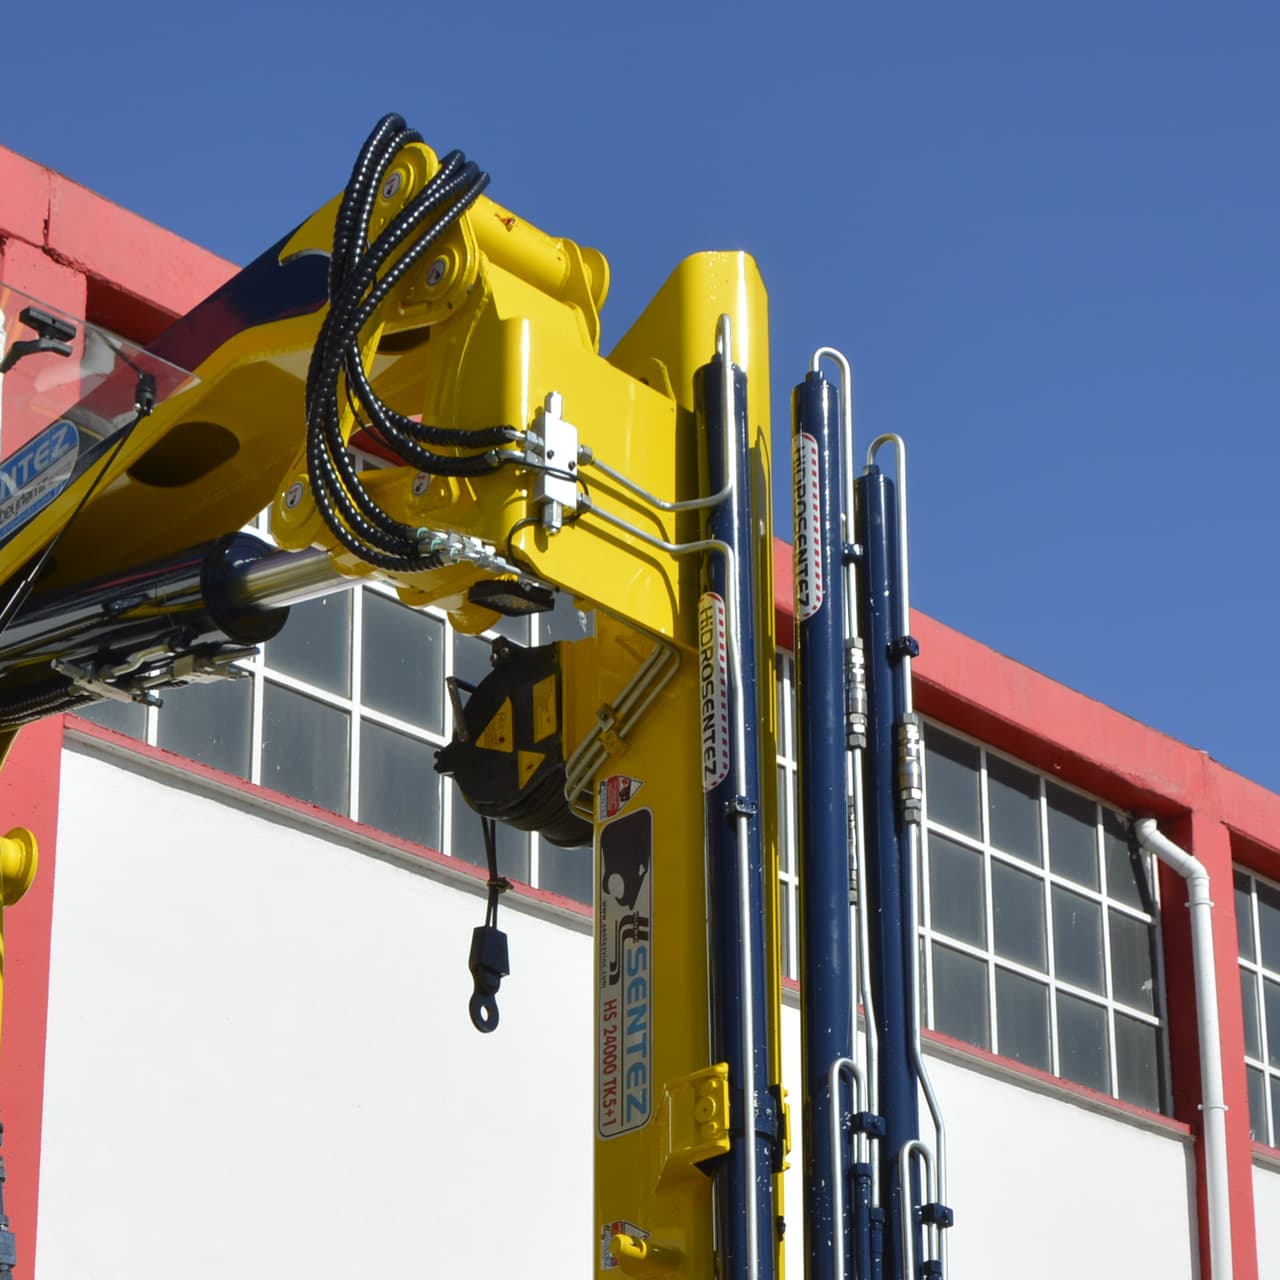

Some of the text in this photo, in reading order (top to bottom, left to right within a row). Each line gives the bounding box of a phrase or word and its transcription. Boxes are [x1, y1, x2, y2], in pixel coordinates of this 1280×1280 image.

[603, 998, 618, 1128] HS 24000 TK5+1
[626, 945, 648, 1124] SENTEZ
